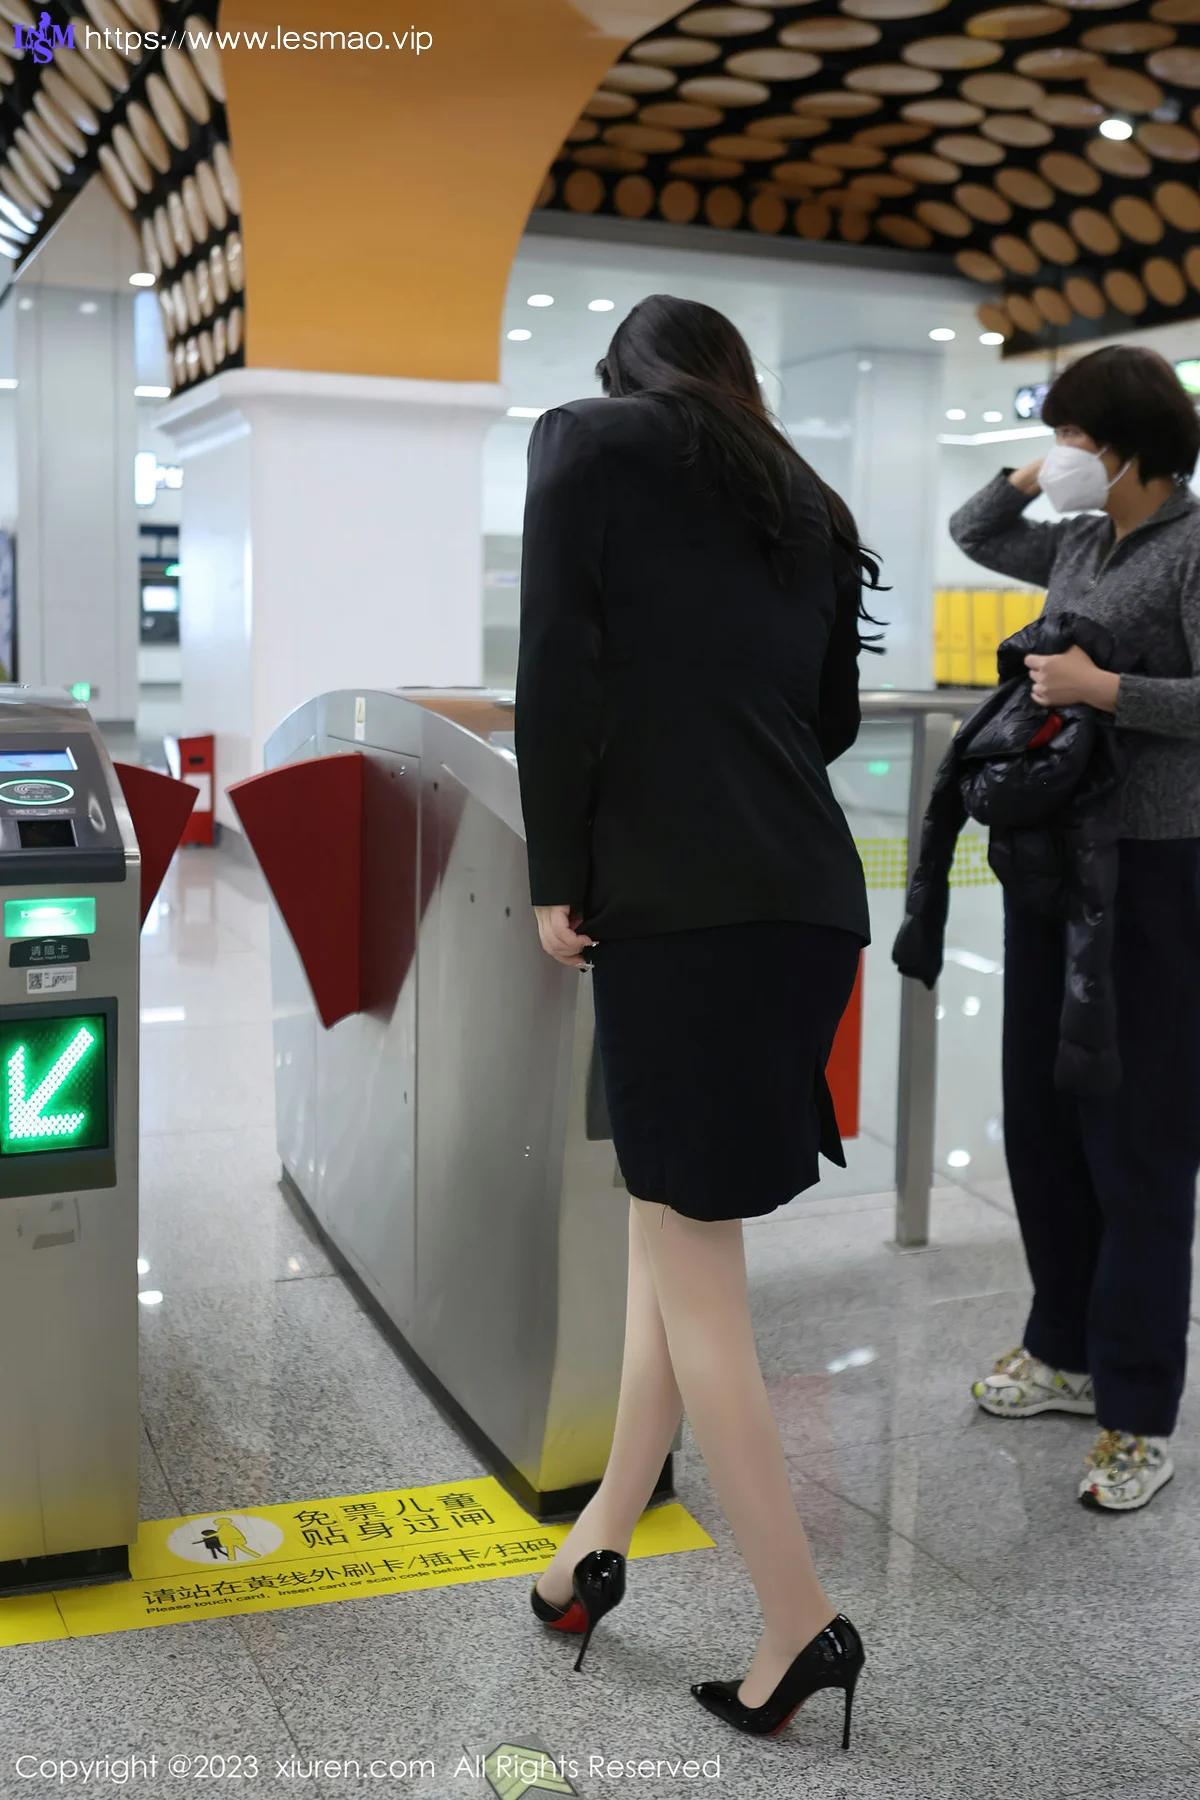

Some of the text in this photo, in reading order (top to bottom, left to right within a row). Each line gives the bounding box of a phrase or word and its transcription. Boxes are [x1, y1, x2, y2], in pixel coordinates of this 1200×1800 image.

[293, 1491, 483, 1529] 免票儿童
[301, 1508, 496, 1549] 贴身过闸
[142, 1537, 558, 1606] 请站在黄线外刷卡/插卡/扫码
[145, 1603, 192, 1614] Please
[195, 1597, 233, 1608] touch
[278, 1586, 316, 1597] insert
[318, 1581, 347, 1591] card
[349, 1580, 363, 1588] or
[366, 1575, 397, 1584] scan
[399, 1569, 430, 1580] code
[431, 1563, 476, 1575] behind
[476, 1559, 497, 1568] the
[499, 1555, 538, 1567] yellow
